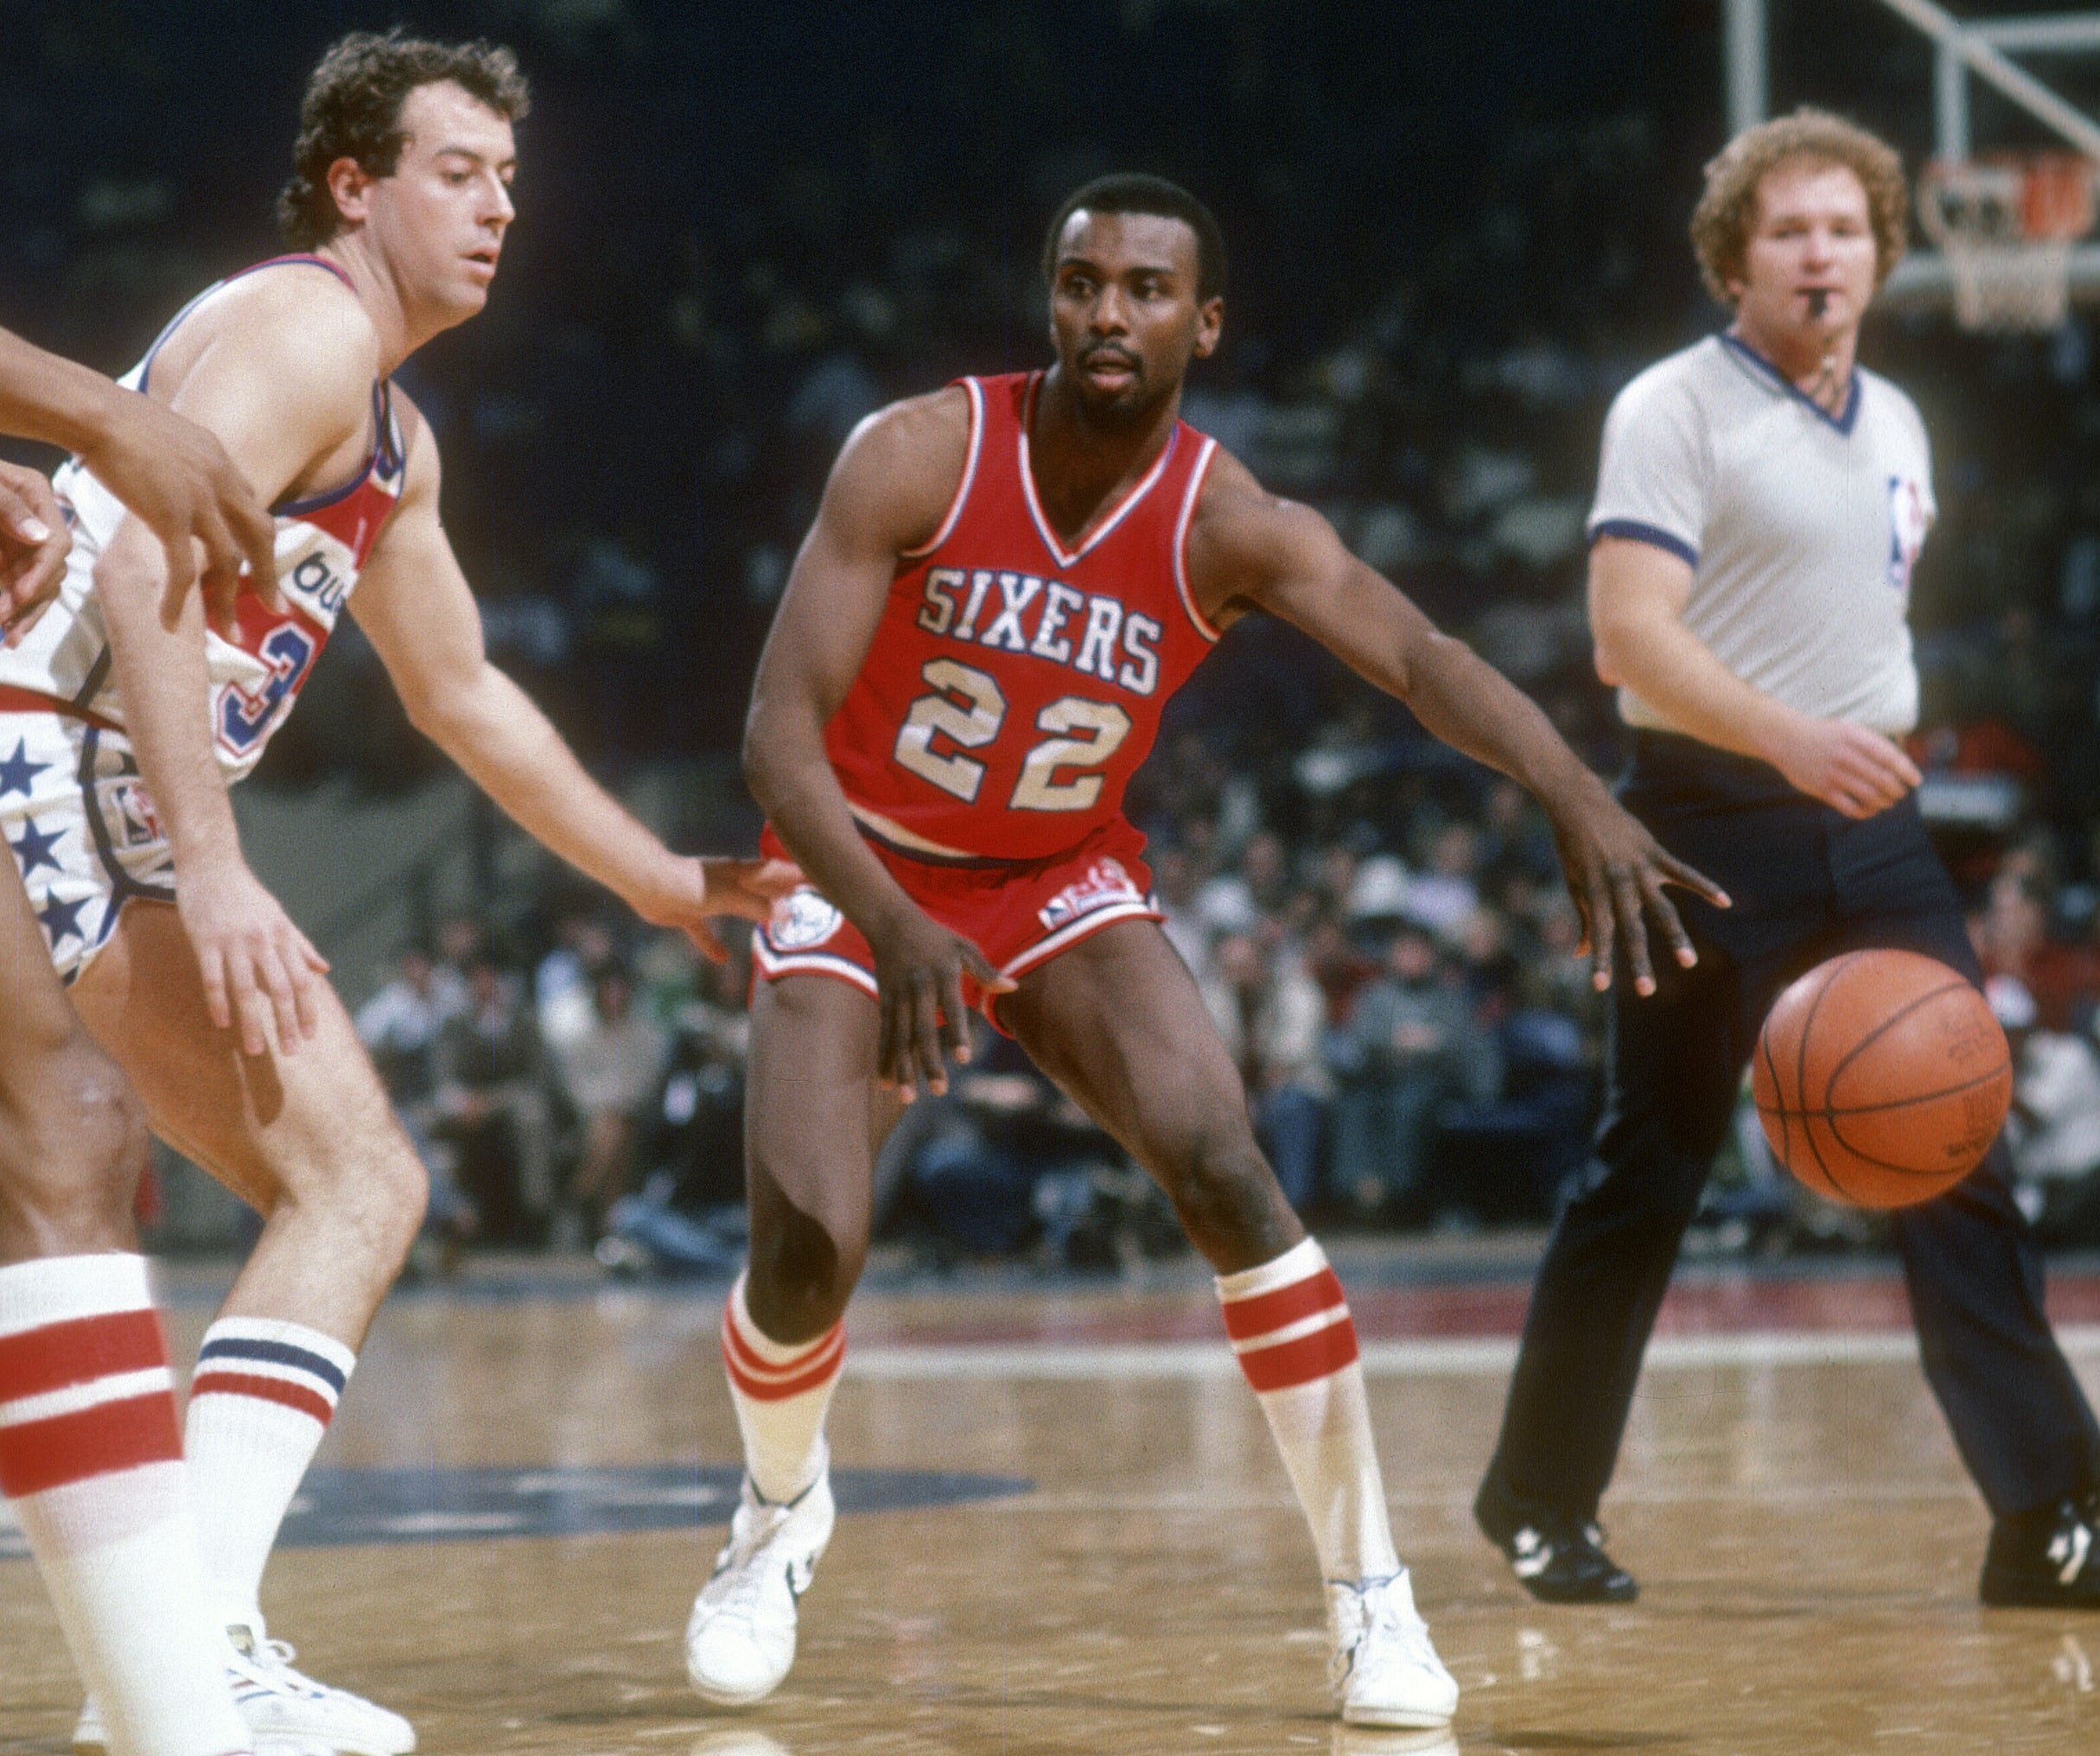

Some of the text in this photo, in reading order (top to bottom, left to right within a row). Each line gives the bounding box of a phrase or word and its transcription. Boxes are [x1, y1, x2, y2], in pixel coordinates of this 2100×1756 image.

[217, 620, 315, 757] 3
[916, 566, 1163, 697] SIXERS
[893, 656, 1132, 812] 22
